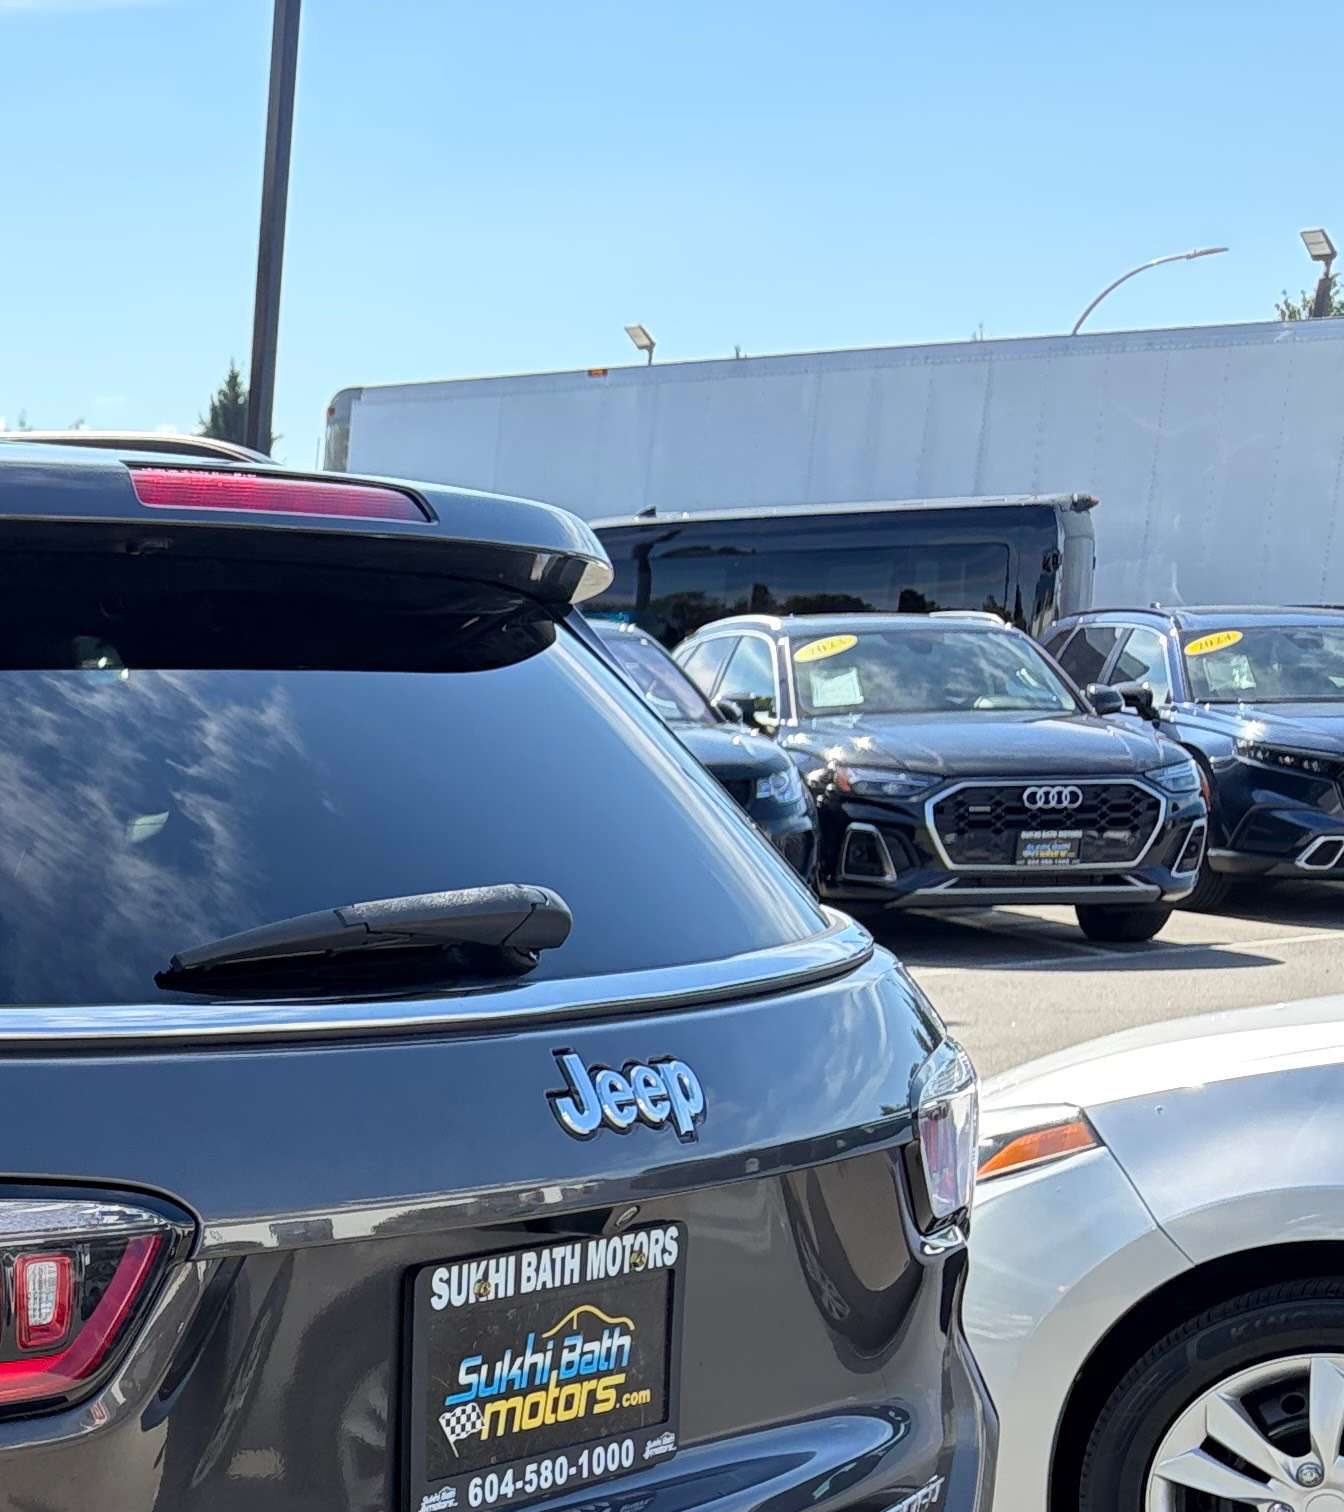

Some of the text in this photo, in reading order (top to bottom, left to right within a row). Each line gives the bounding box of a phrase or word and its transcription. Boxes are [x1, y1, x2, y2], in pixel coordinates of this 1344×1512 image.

[547, 1049, 706, 1141] Jeep
[430, 1225, 679, 1311] SUKHI BATH MOTORS
[444, 1326, 632, 1407] Sukhi Bath
[468, 1438, 635, 1509] 604-580-1000
